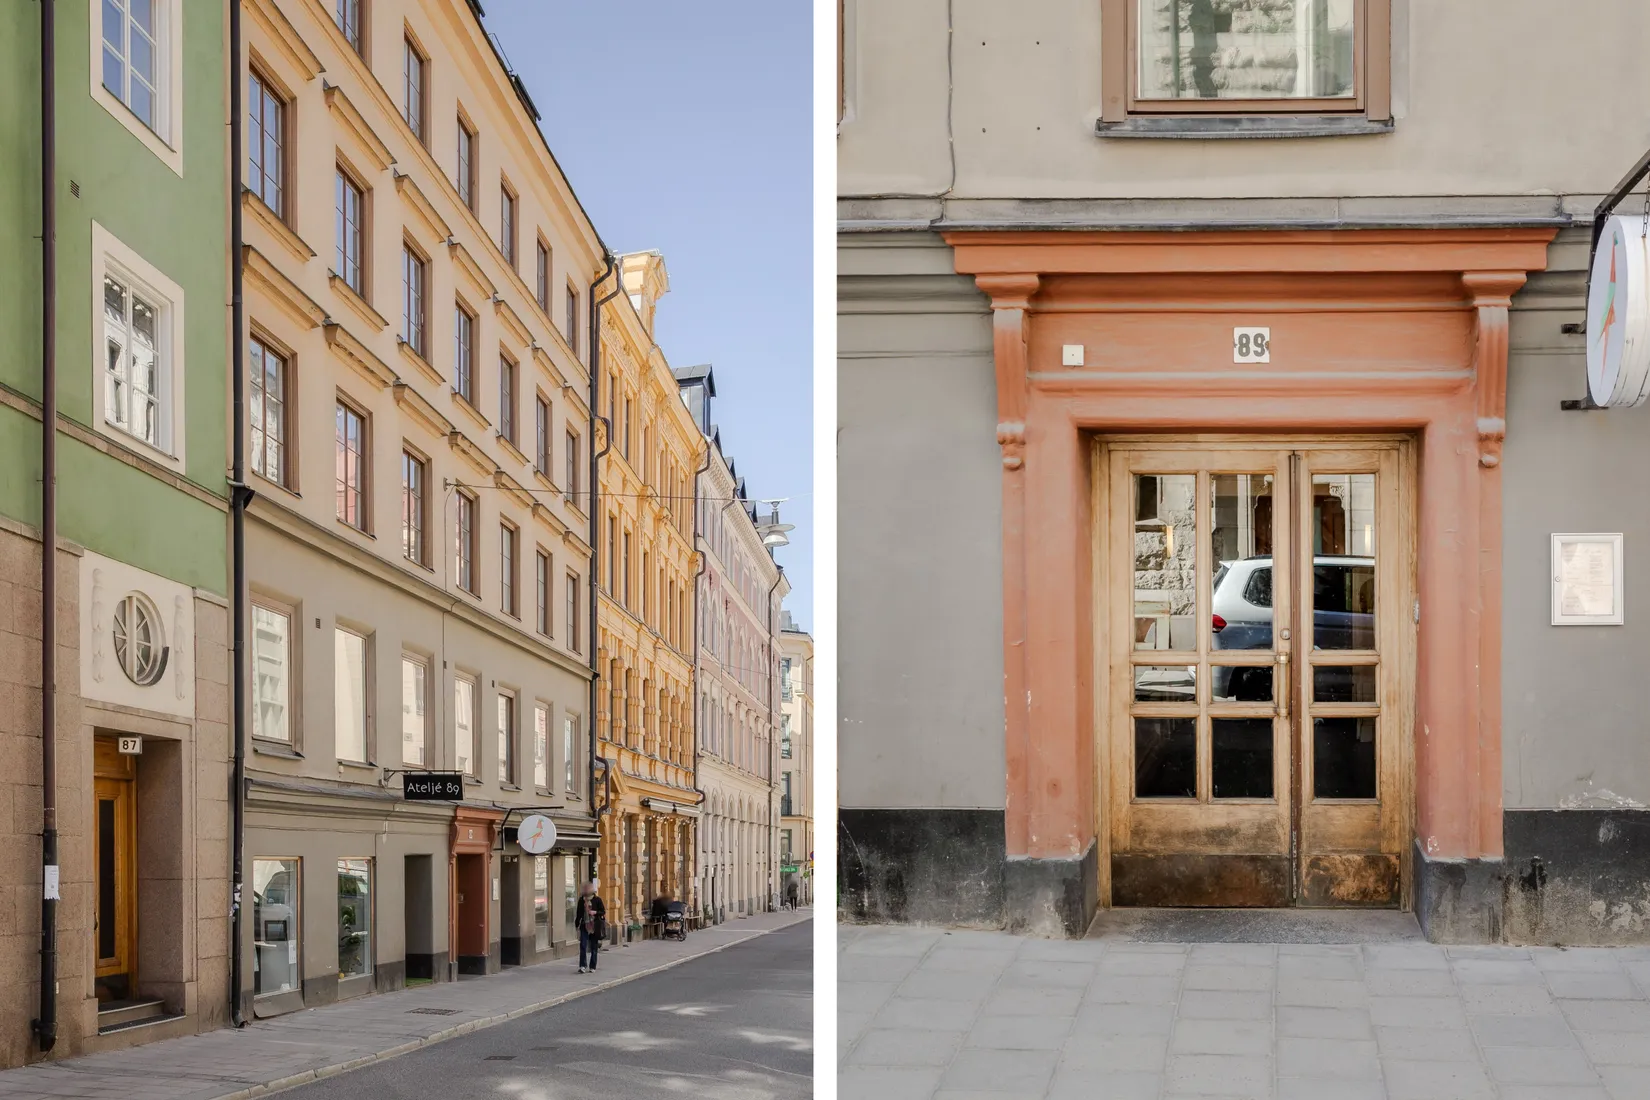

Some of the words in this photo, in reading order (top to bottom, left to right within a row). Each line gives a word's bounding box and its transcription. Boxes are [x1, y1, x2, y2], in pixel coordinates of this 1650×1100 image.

[1238, 333, 1265, 357] 89
[122, 740, 136, 750] 87
[407, 782, 442, 795] Ateljé
[446, 782, 460, 795] 89
